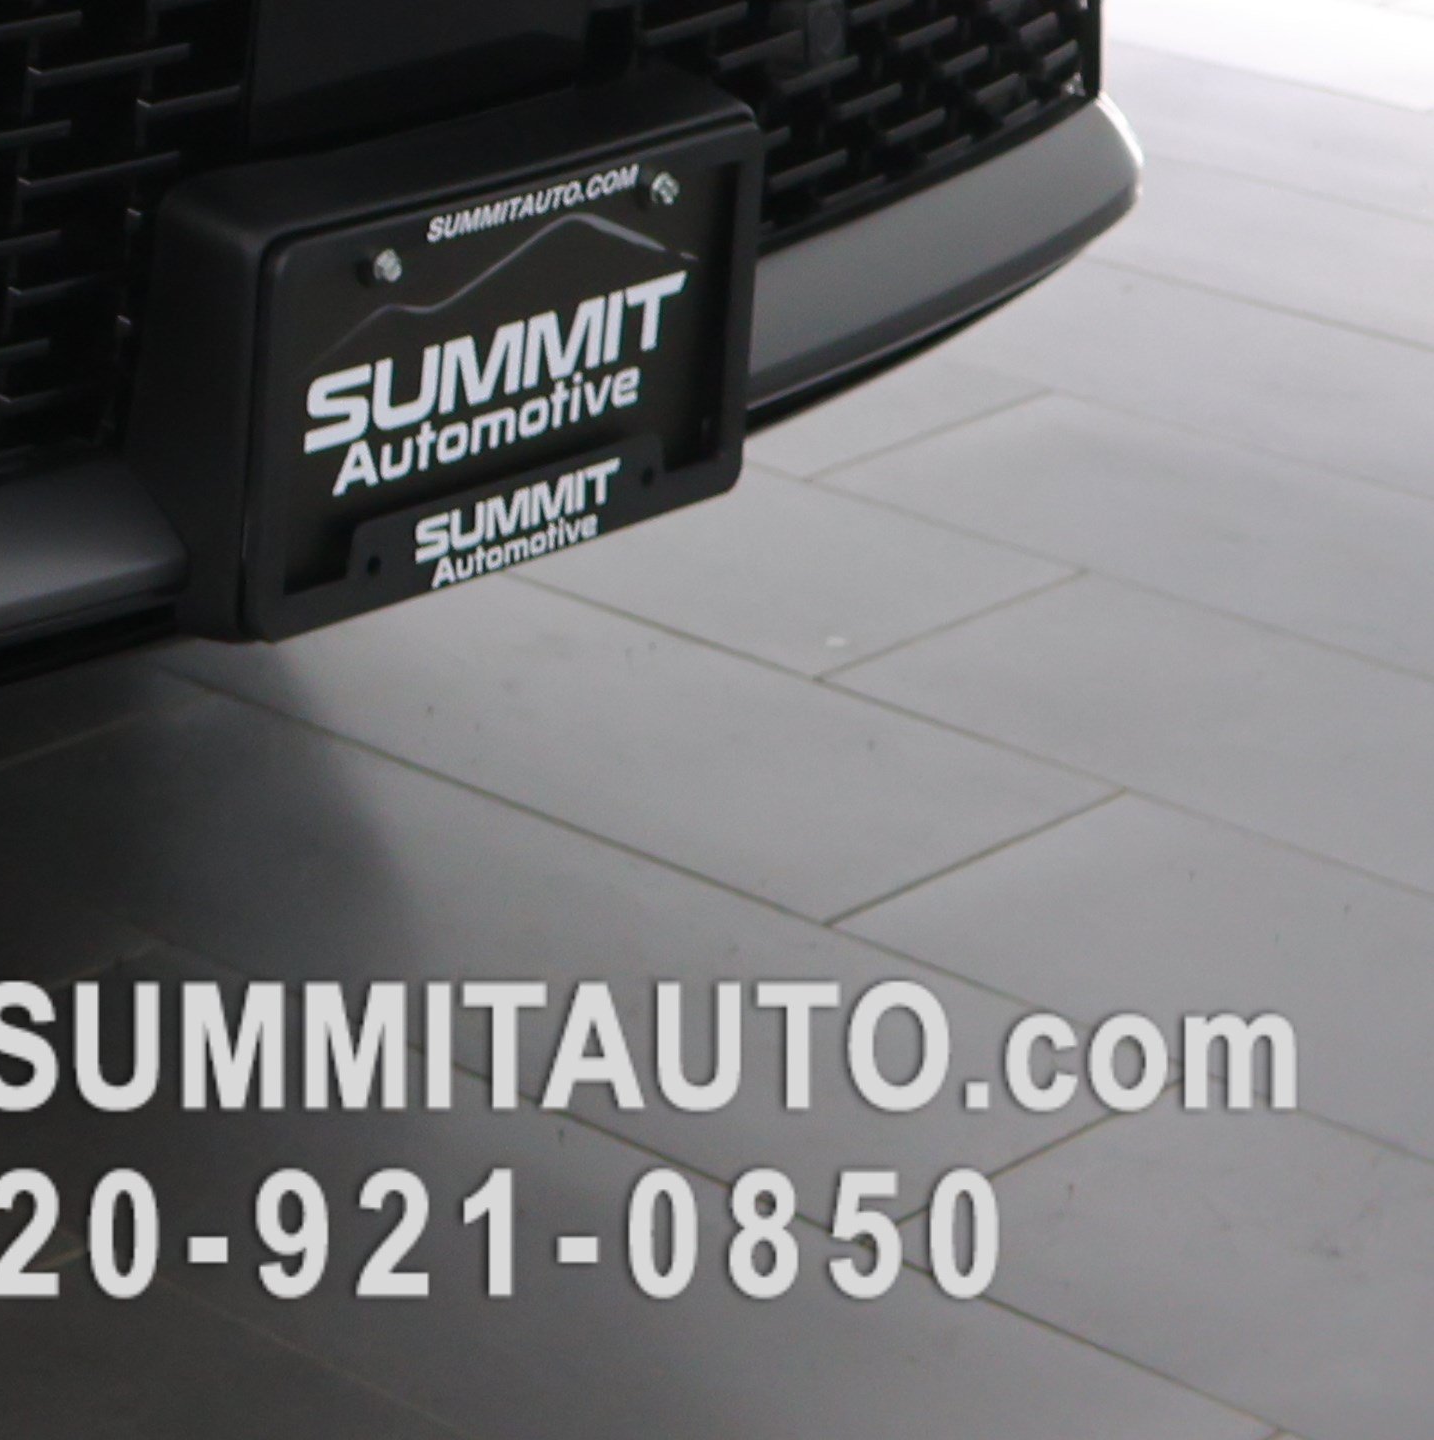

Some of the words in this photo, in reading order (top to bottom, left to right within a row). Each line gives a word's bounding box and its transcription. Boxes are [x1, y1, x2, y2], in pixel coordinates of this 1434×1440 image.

[426, 163, 639, 244] SUMMITAUTO.COM
[303, 270, 688, 455] SUMMIT
[331, 363, 640, 498] Automotive
[413, 457, 621, 564] SUMMIT
[430, 511, 599, 589] Automotive
